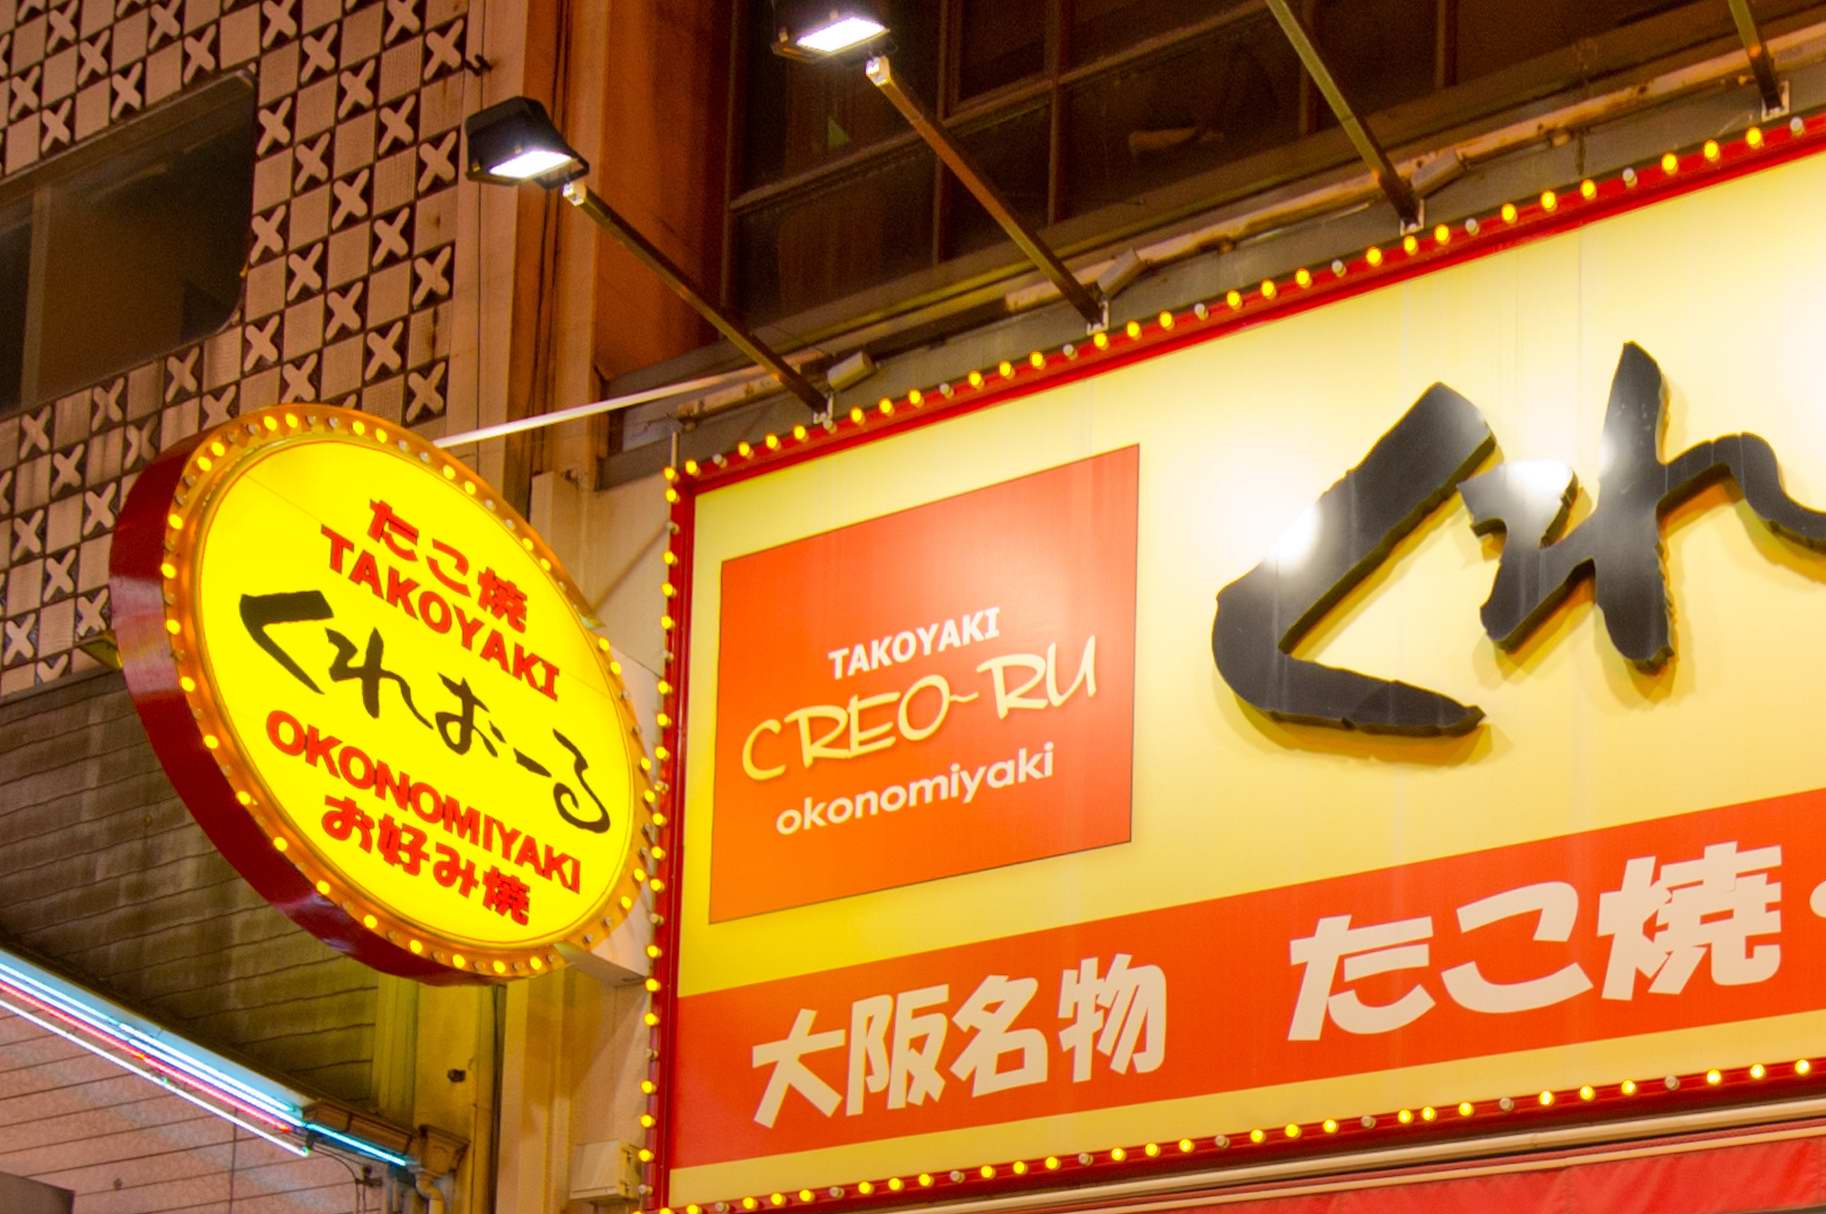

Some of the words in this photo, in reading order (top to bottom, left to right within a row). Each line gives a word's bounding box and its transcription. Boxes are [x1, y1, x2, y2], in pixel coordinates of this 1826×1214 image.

[320, 525, 559, 702] TAKOYAKI
[368, 500, 528, 632] たこ焼
[240, 590, 610, 834] くれおーる
[829, 606, 1001, 681] TAKOYAKI
[266, 709, 582, 894] OKONOMIYAKI
[322, 795, 531, 926] お好み焼
[775, 741, 1056, 837] okonomiyaki
[751, 952, 1169, 1131] 大阪名物
